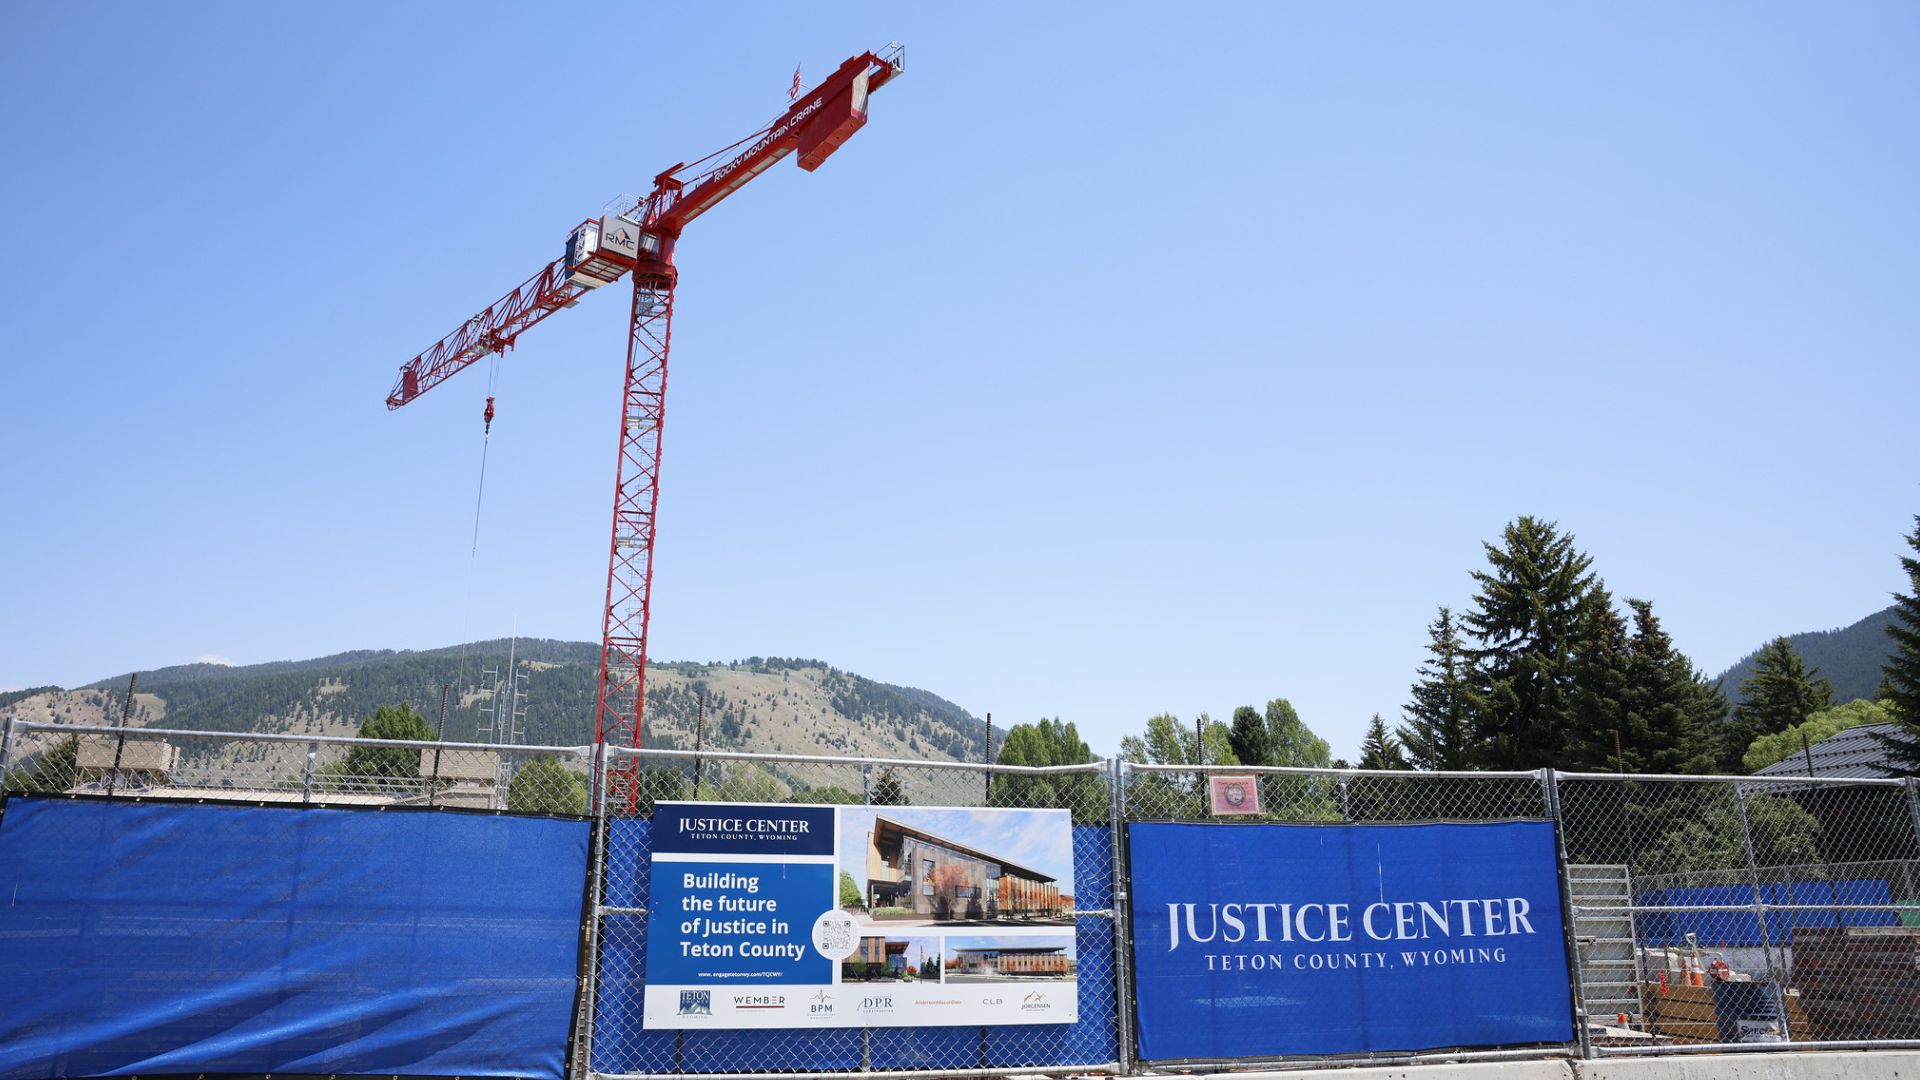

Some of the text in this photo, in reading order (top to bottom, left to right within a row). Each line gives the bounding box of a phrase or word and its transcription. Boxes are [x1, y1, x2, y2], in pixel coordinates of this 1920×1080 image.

[713, 96, 823, 183] ROCKY MOUNTAIN CRANE
[605, 232, 635, 251] RMC
[679, 818, 810, 833] JUSTICE CENTER
[683, 873, 760, 893] Building
[682, 896, 777, 911] the future
[681, 918, 789, 938] of Justice in
[1165, 897, 1537, 952] JUSTICE CENTER
[680, 942, 806, 961] Teton County
[1205, 947, 1507, 970] TETON COUNTY, WYOMING
[680, 991, 709, 1000] TETON
[734, 996, 785, 1004] WEMBER
[864, 997, 893, 1008] DPR
[810, 1004, 833, 1013] BPM
